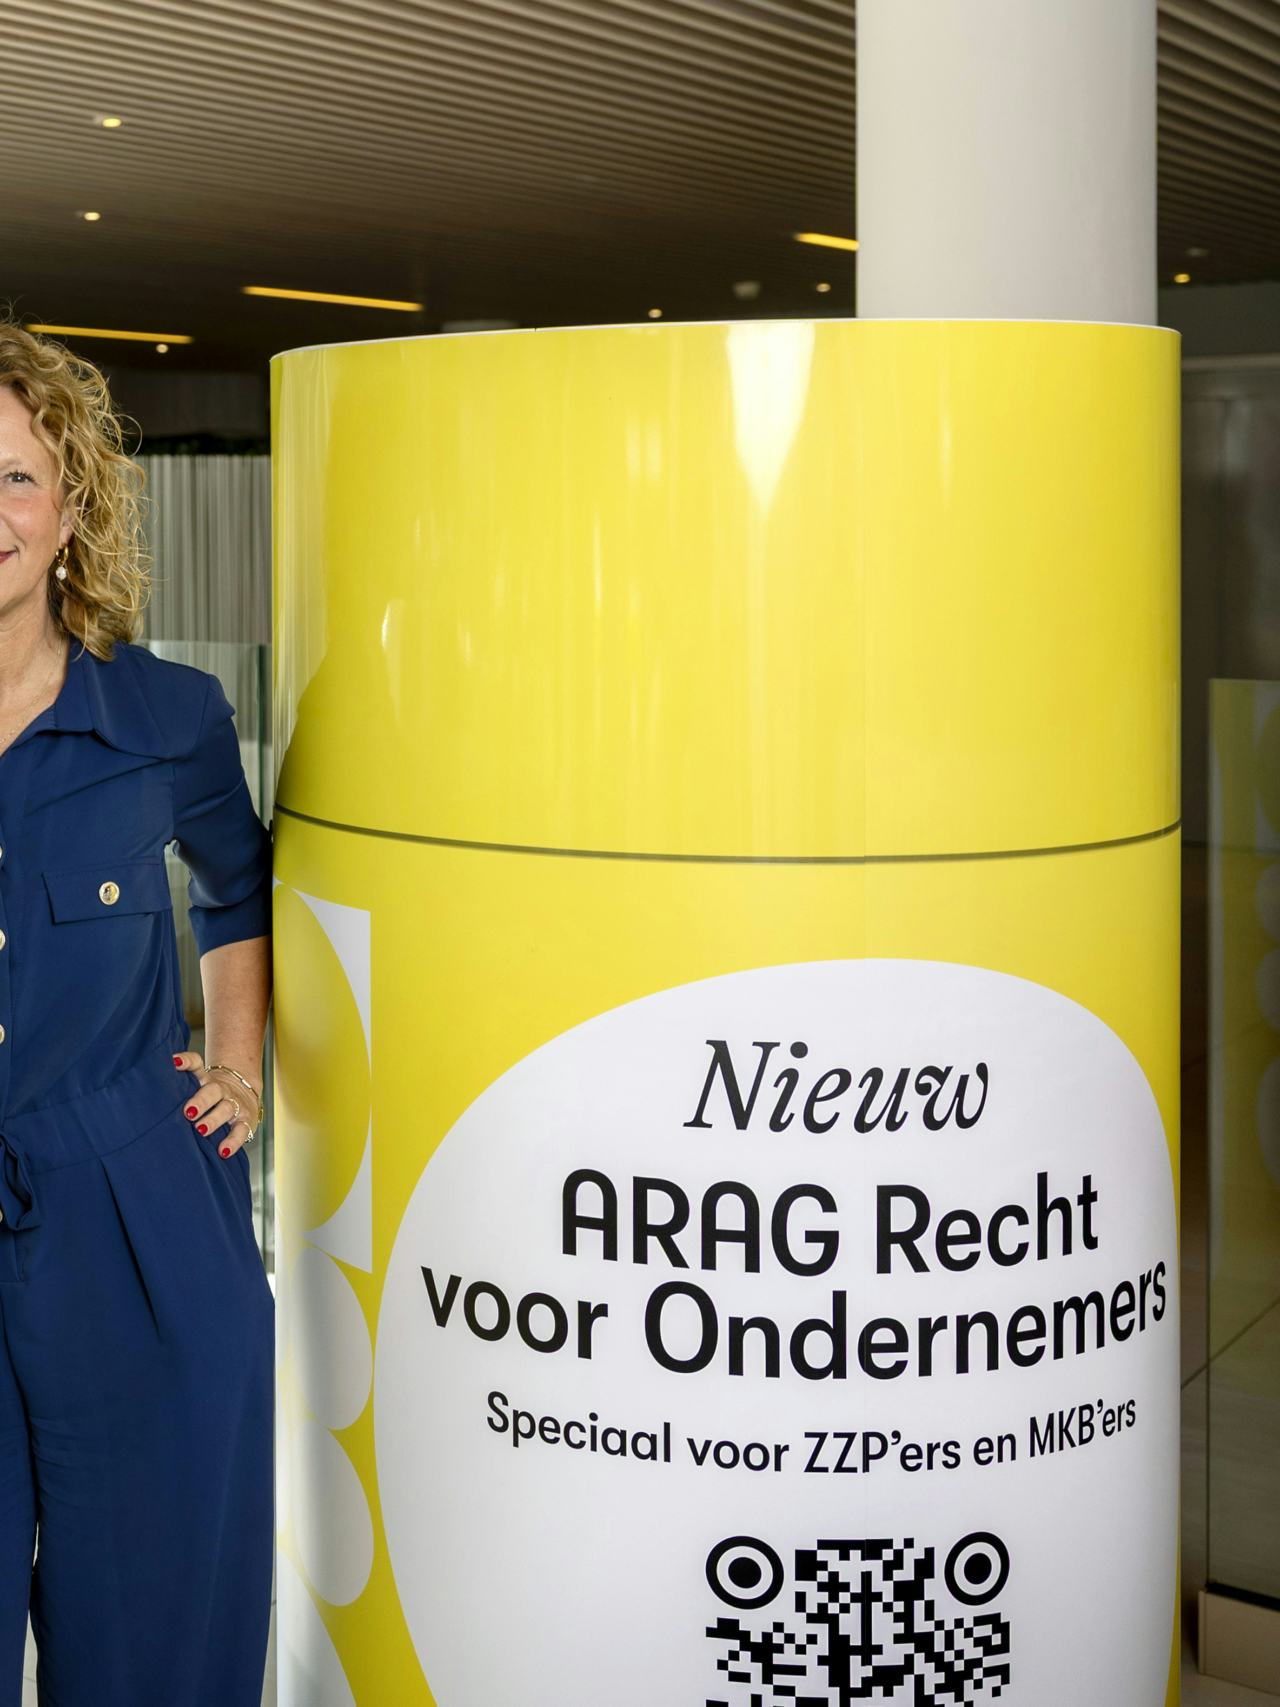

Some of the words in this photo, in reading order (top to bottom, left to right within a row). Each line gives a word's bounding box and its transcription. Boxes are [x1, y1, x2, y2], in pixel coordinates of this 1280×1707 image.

[683, 1040, 988, 1133] Nieuw
[562, 1169, 839, 1276] ARAG
[876, 1172, 1099, 1274] Recht
[420, 1265, 608, 1359] voor
[644, 1260, 1167, 1380] Ondernemers
[486, 1391, 671, 1463] Speciaal
[686, 1437, 790, 1472] voor
[803, 1430, 961, 1473] ZZP’ers
[973, 1433, 1017, 1466] en
[1029, 1398, 1136, 1458] MKB’ers
